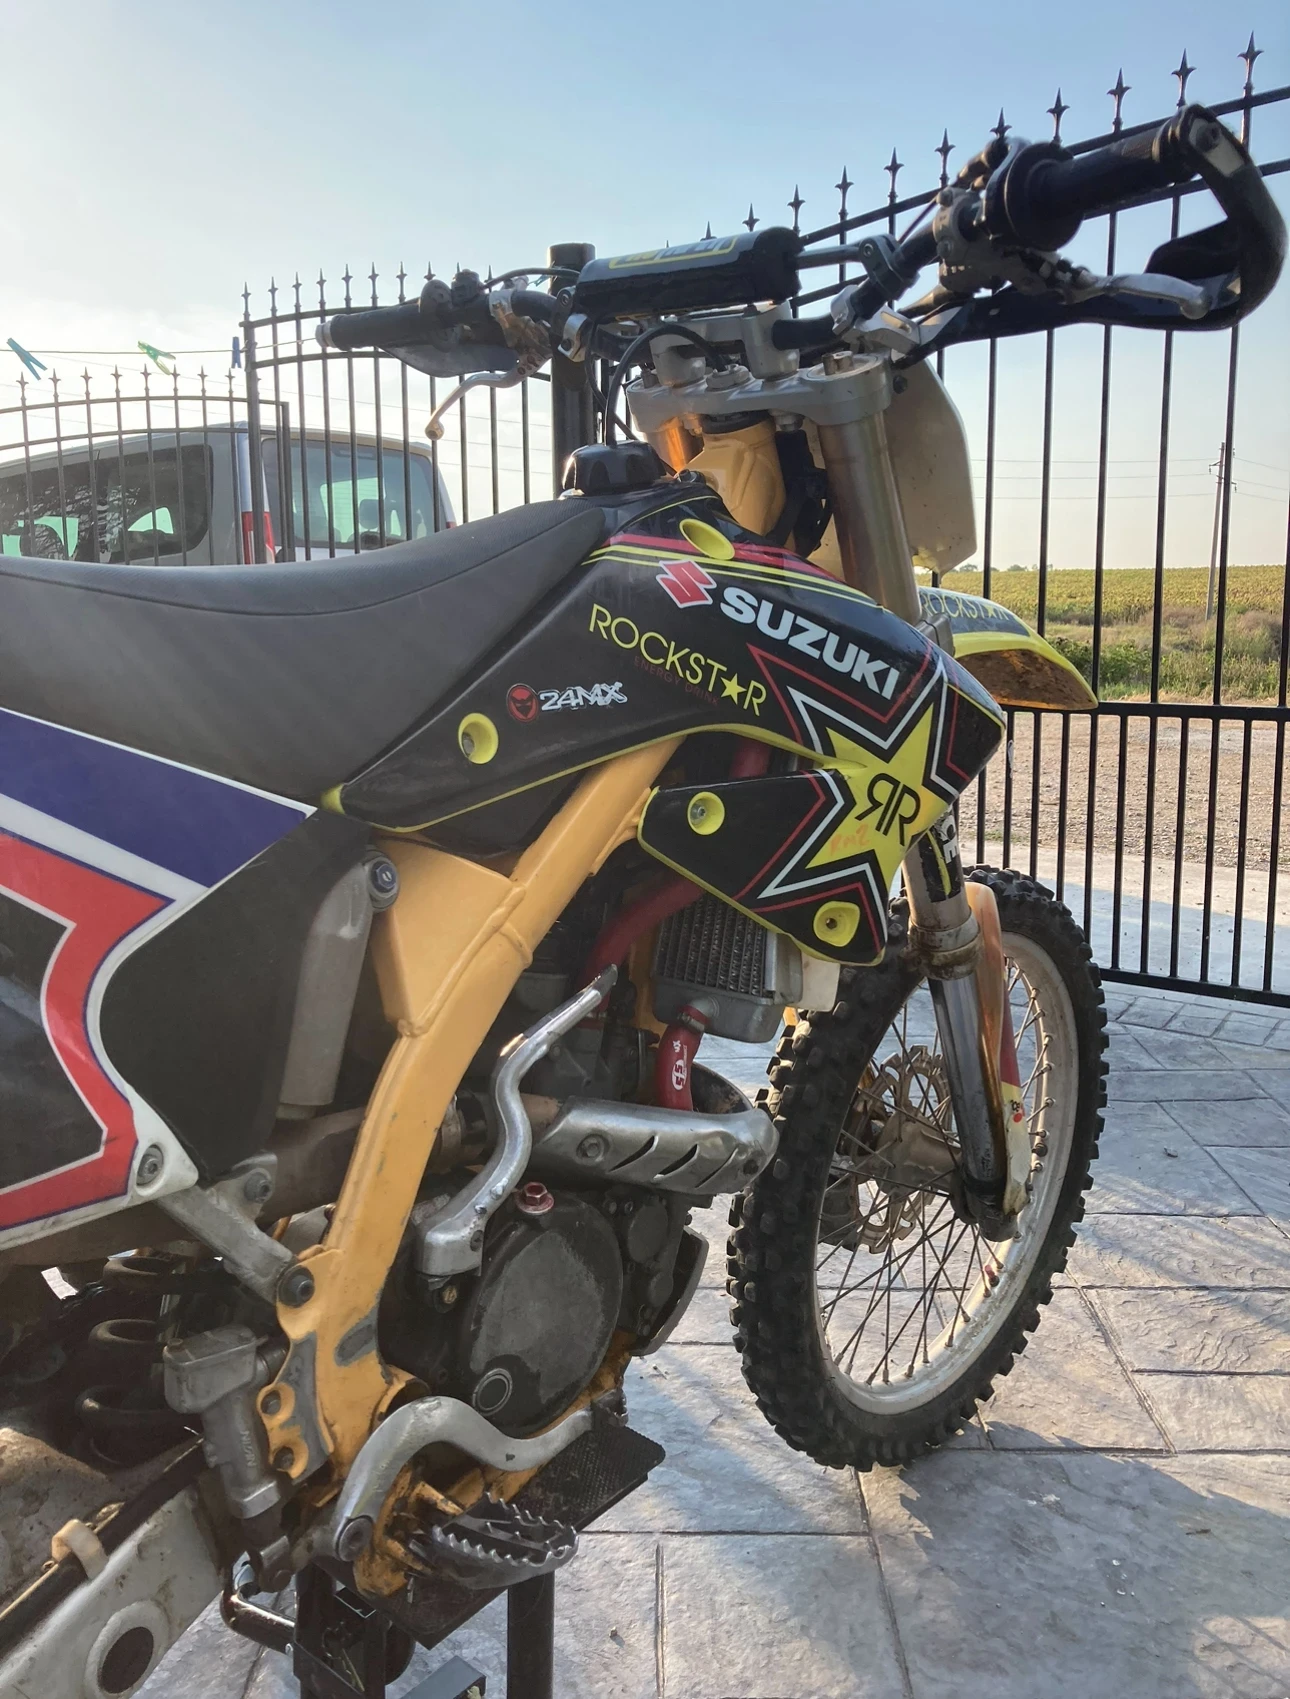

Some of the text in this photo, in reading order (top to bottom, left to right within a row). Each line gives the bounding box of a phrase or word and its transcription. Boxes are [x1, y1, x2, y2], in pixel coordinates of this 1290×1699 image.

[720, 587, 900, 700] SUZUKI
[539, 681, 628, 711] 24MX
[634, 655, 720, 707] ENERGY DRINK
